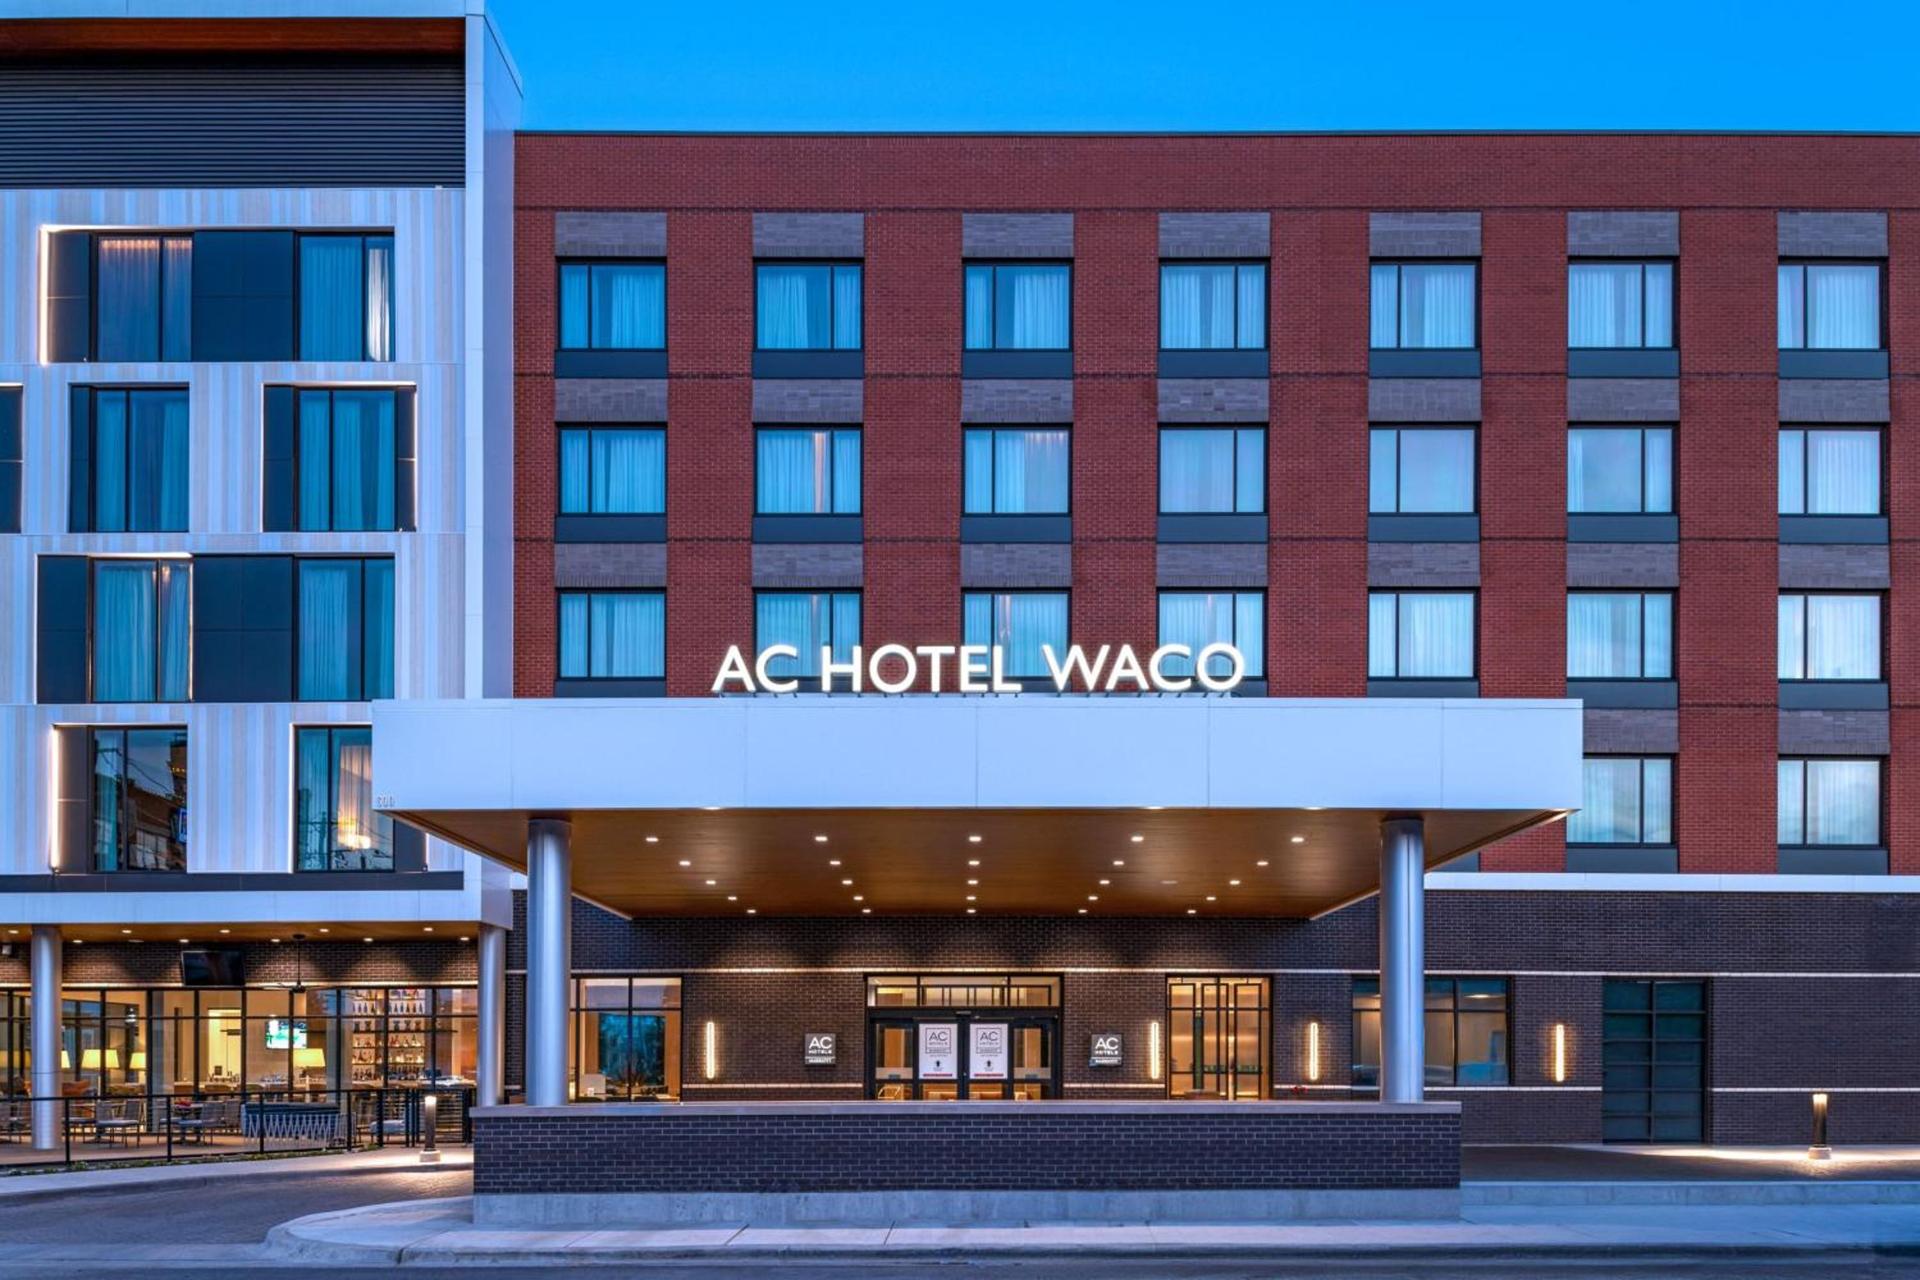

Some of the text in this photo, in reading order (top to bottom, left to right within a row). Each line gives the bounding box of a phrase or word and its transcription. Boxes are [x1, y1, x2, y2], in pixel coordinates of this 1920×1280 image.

[712, 643, 1244, 692] AC HOTEL WACO
[809, 1036, 832, 1049] AC
[929, 1031, 948, 1041] AC
[980, 1031, 998, 1041] AC
[1095, 1037, 1119, 1050] AC
